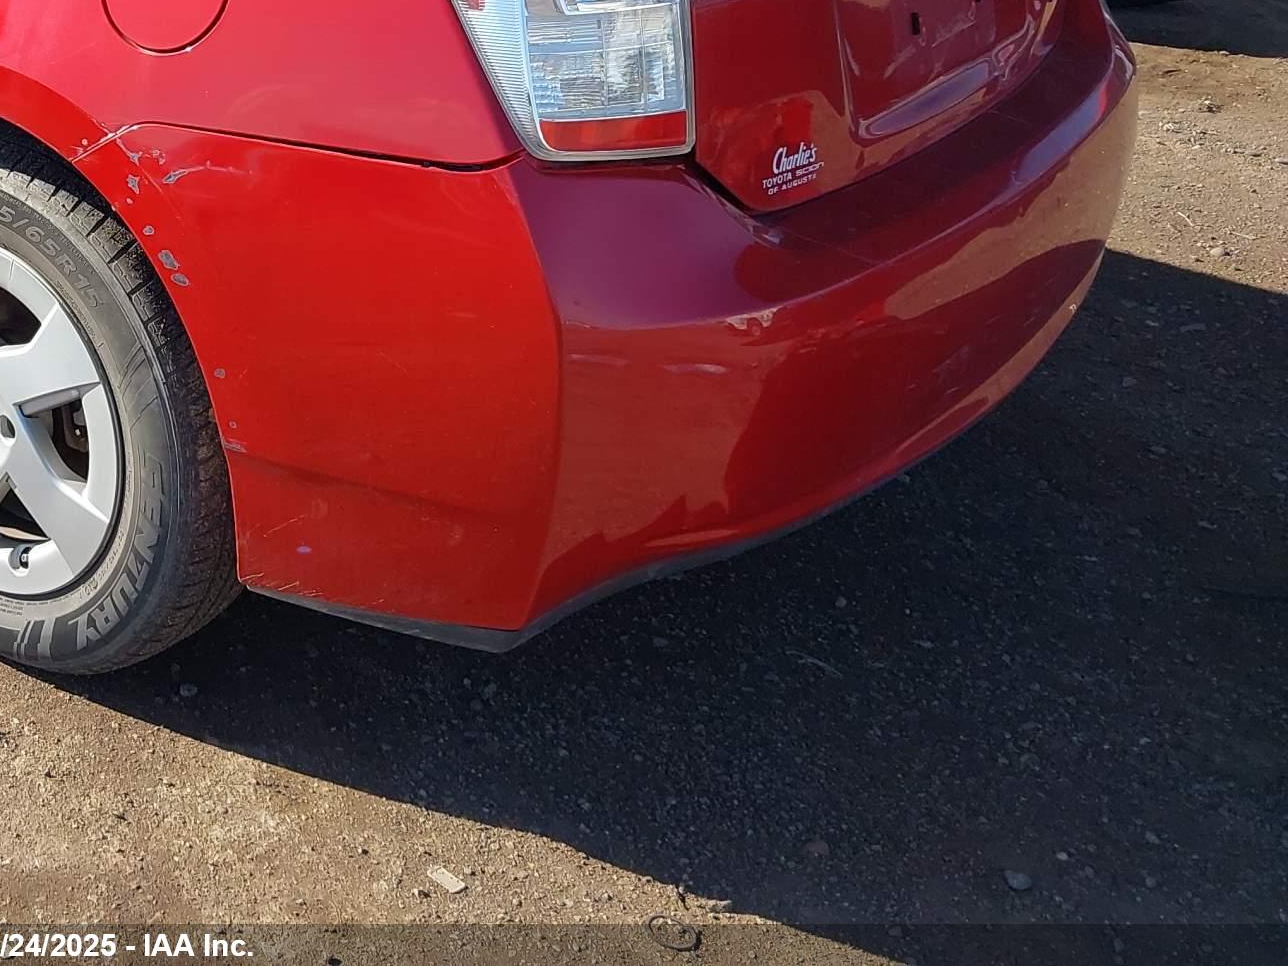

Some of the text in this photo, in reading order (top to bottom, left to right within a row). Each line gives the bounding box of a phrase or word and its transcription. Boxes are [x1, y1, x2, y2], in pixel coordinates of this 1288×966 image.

[773, 141, 818, 174] Charlie's
[762, 171, 792, 189] TOYOTA
[768, 186, 778, 195] OF
